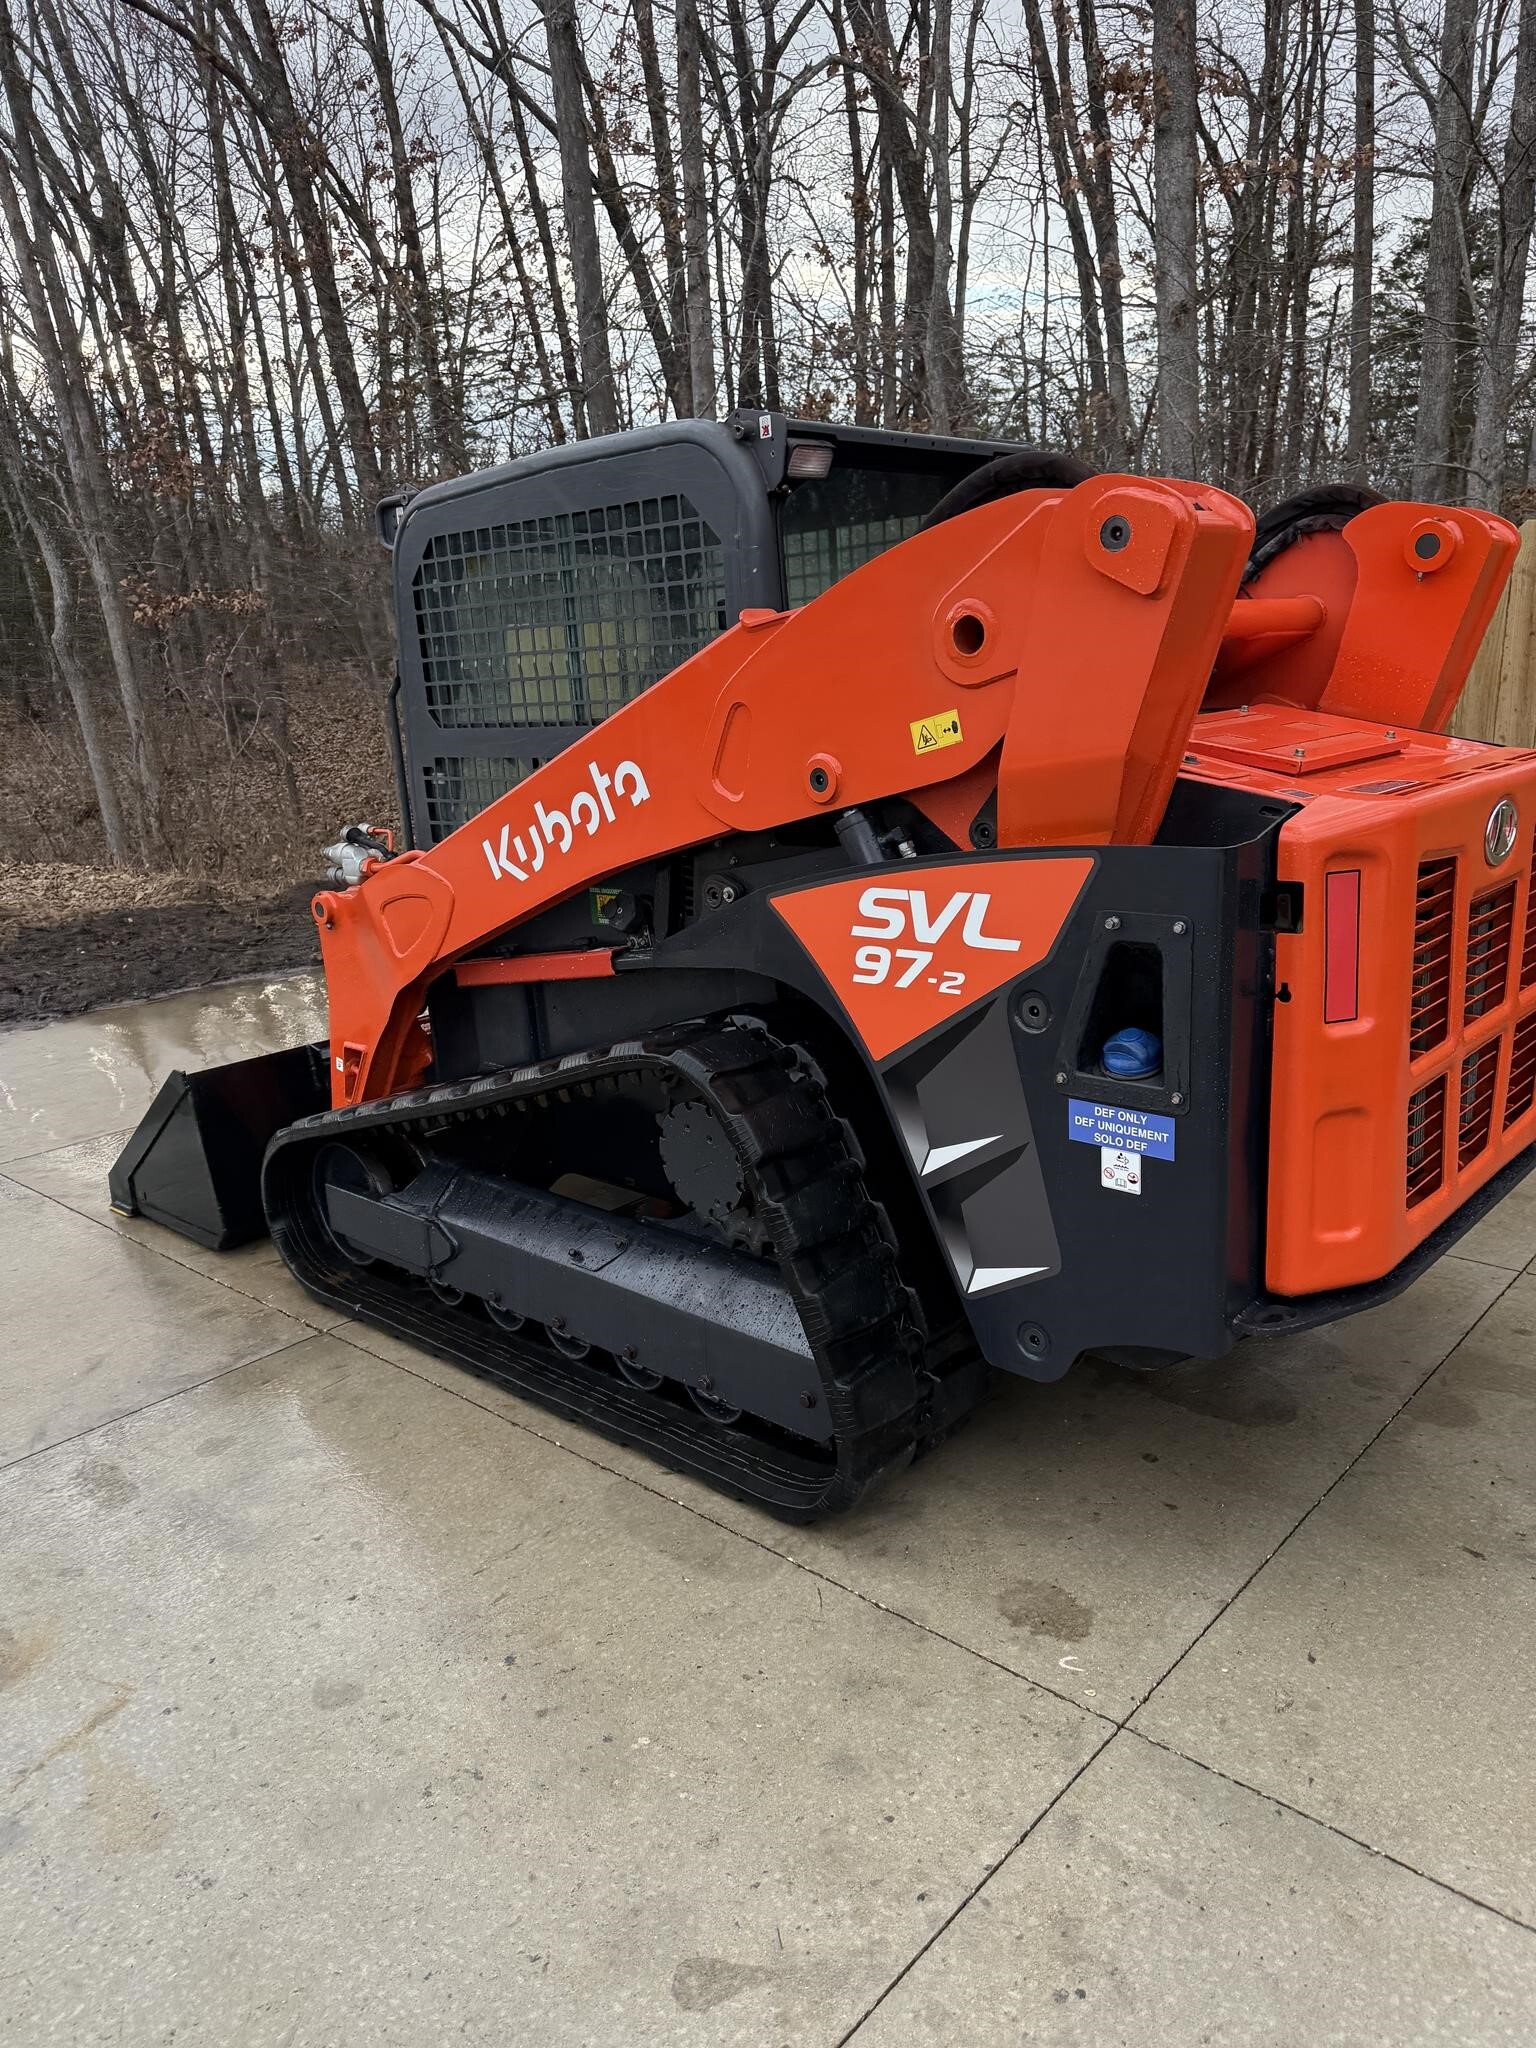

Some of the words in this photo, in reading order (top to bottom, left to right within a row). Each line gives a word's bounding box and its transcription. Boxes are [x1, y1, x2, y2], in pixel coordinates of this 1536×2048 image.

[482, 760, 651, 882] Kubota
[851, 887, 1021, 951] SVL
[852, 945, 966, 995] 97-2
[1074, 1116, 1095, 1127] DEF
[1098, 1120, 1169, 1143] UNIQUEMENT
[1094, 1106, 1115, 1119] DEF
[1118, 1111, 1148, 1125] ONLY
[1094, 1133, 1123, 1147] SOLO
[1126, 1140, 1148, 1152] DEF
